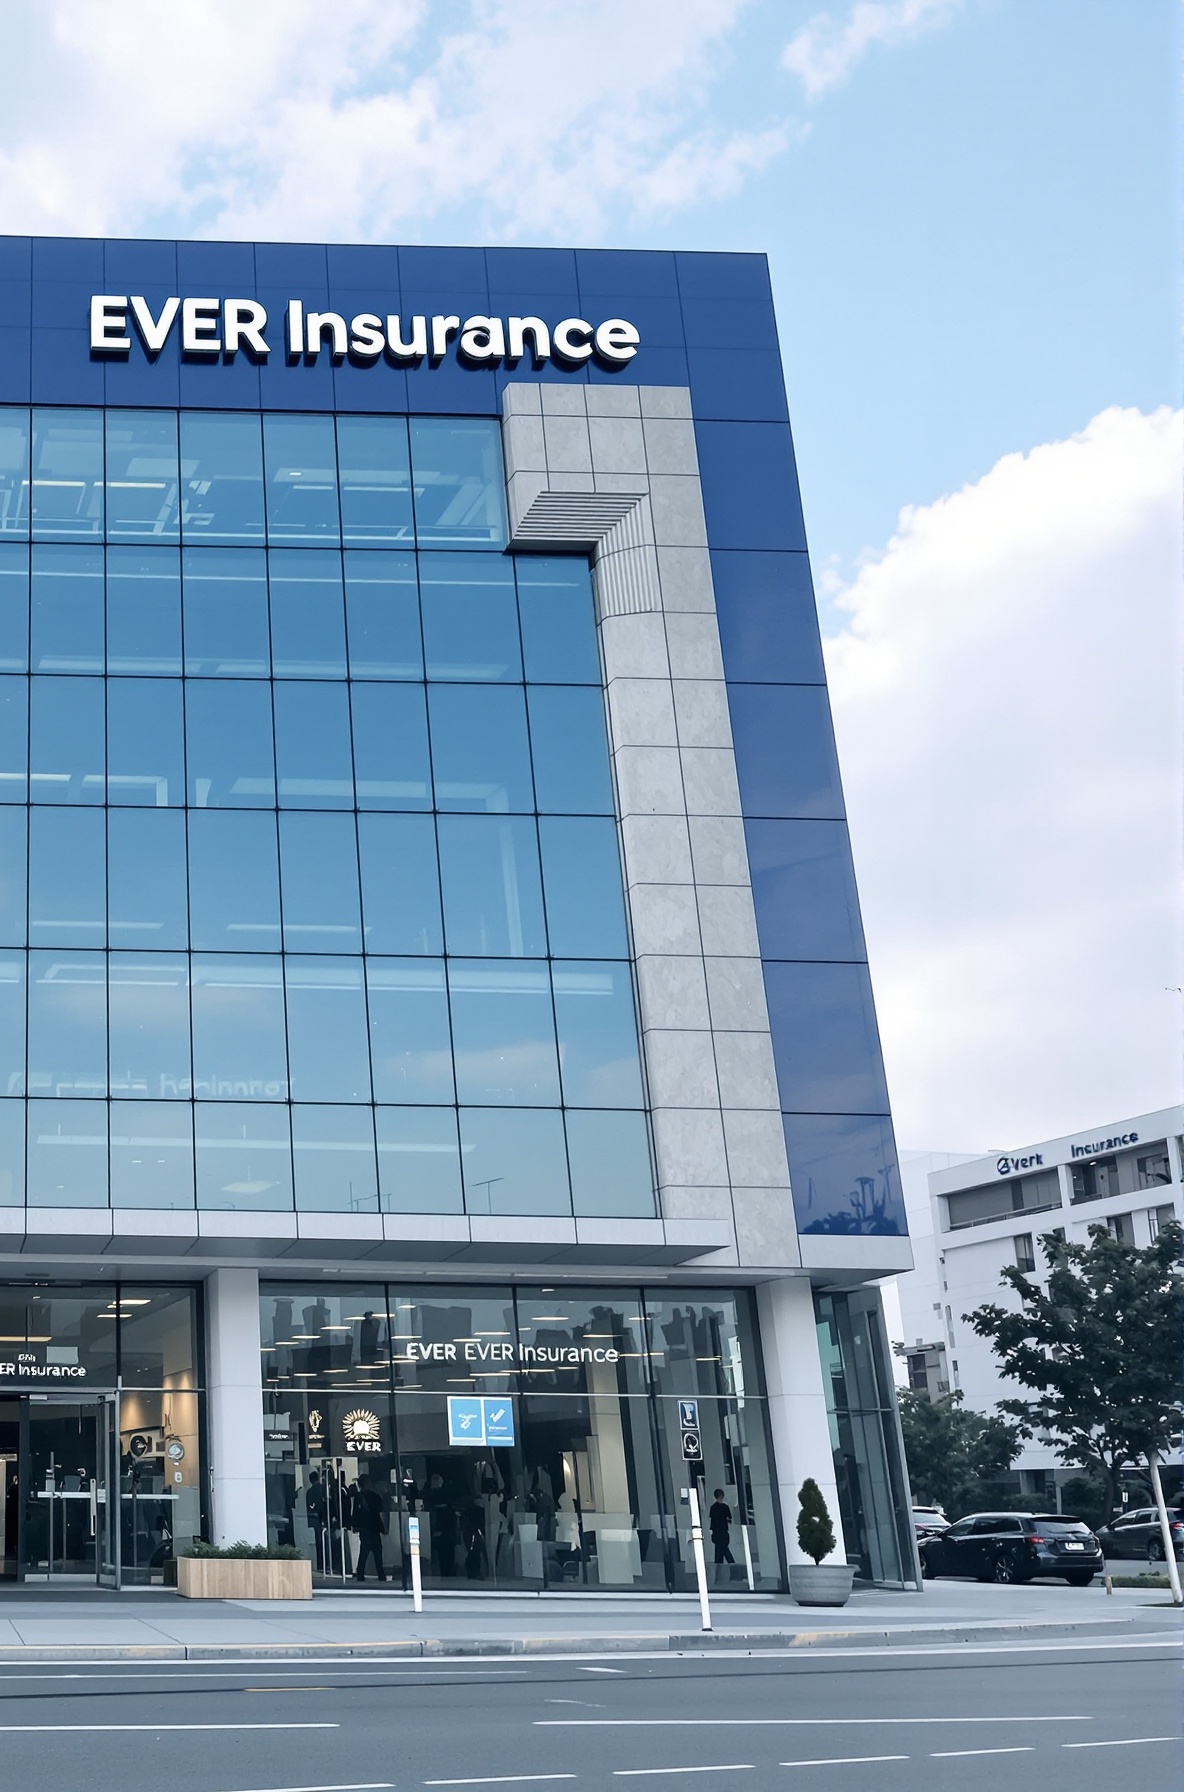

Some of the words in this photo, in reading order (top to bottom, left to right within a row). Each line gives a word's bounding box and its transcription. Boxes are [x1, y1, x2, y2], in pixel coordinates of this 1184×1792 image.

[90, 294, 271, 355] EVER
[287, 299, 640, 365] Insurance
[406, 1342, 457, 1361] EVER
[465, 1342, 514, 1361] EVER
[519, 1342, 619, 1363] Insurance
[18, 1363, 87, 1377] Insurance
[346, 1441, 382, 1452] EVER
